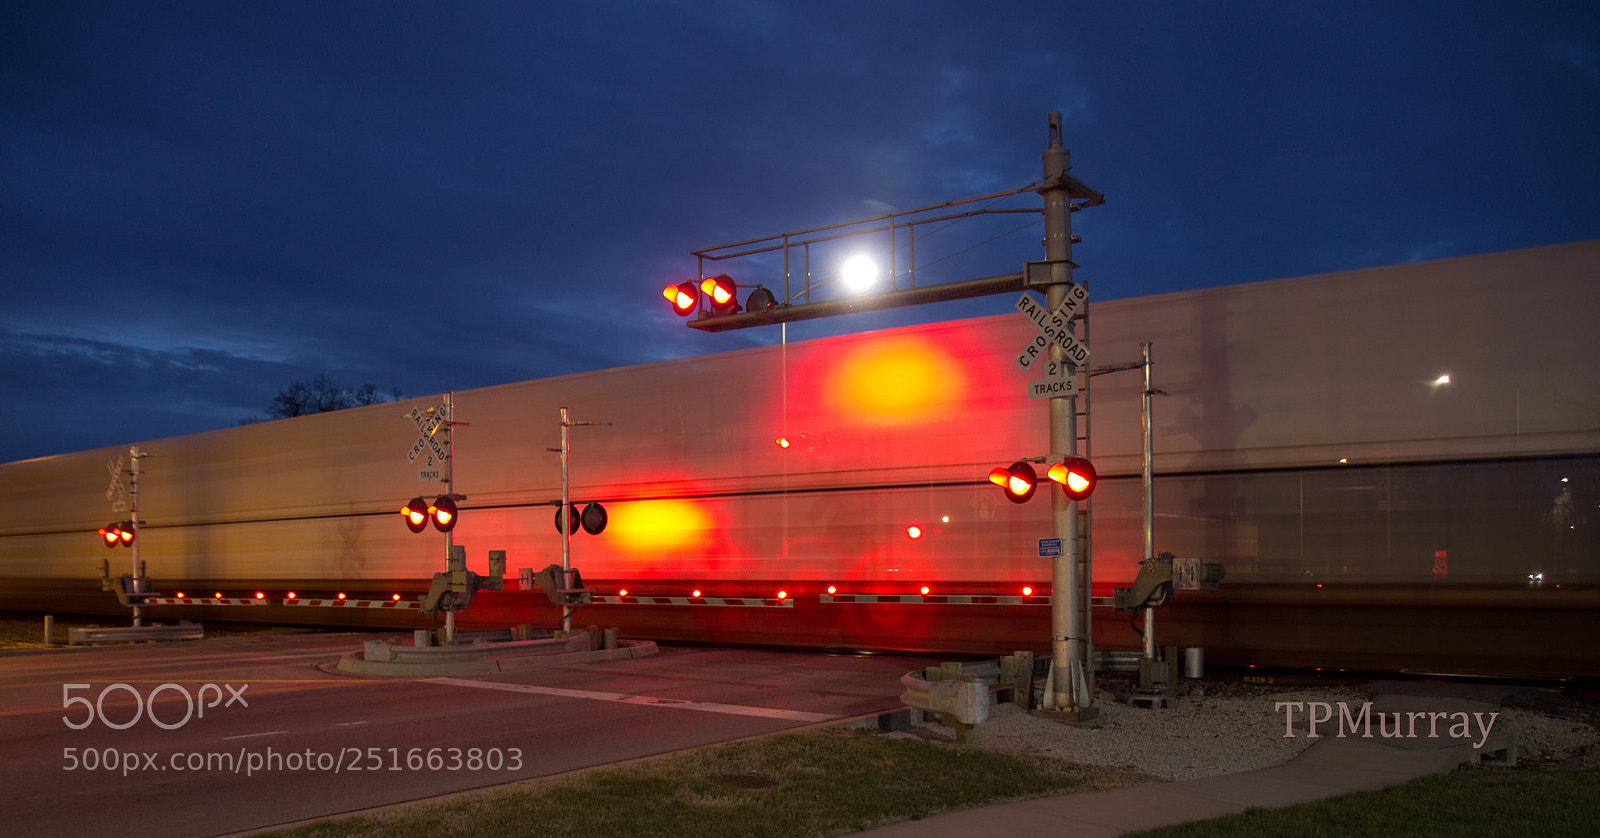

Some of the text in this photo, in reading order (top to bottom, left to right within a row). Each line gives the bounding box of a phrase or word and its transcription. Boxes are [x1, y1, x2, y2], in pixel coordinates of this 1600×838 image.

[1019, 287, 1085, 367] CROSSING
[1048, 363, 1057, 375] 2
[1034, 381, 1072, 394] TRACKS
[408, 407, 446, 460] CROSSING
[427, 456, 433, 466] 2
[420, 470, 439, 479] TRACKS
